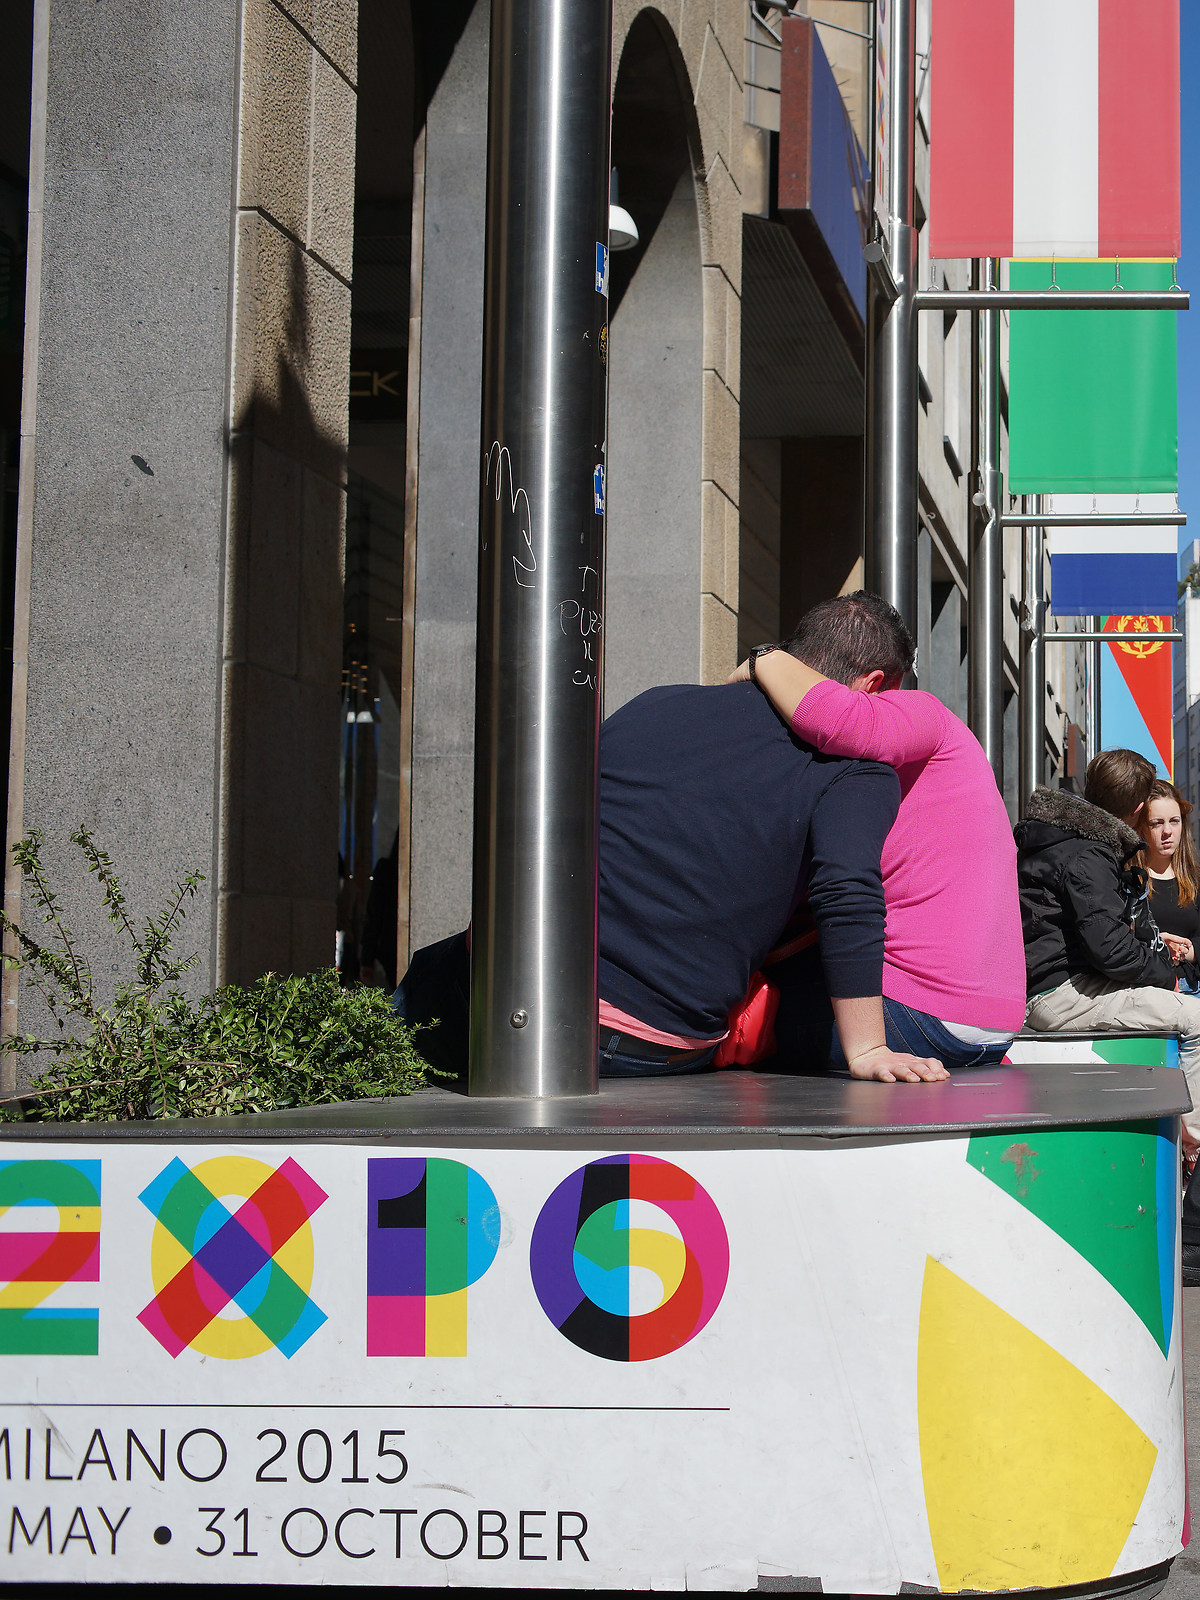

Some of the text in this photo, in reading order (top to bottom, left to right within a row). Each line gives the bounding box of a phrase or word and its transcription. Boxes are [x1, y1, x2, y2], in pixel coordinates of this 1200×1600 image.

[0, 1428, 410, 1484] ILANO 2015
[8, 1505, 591, 1563] MAY 31 OCTOBER
